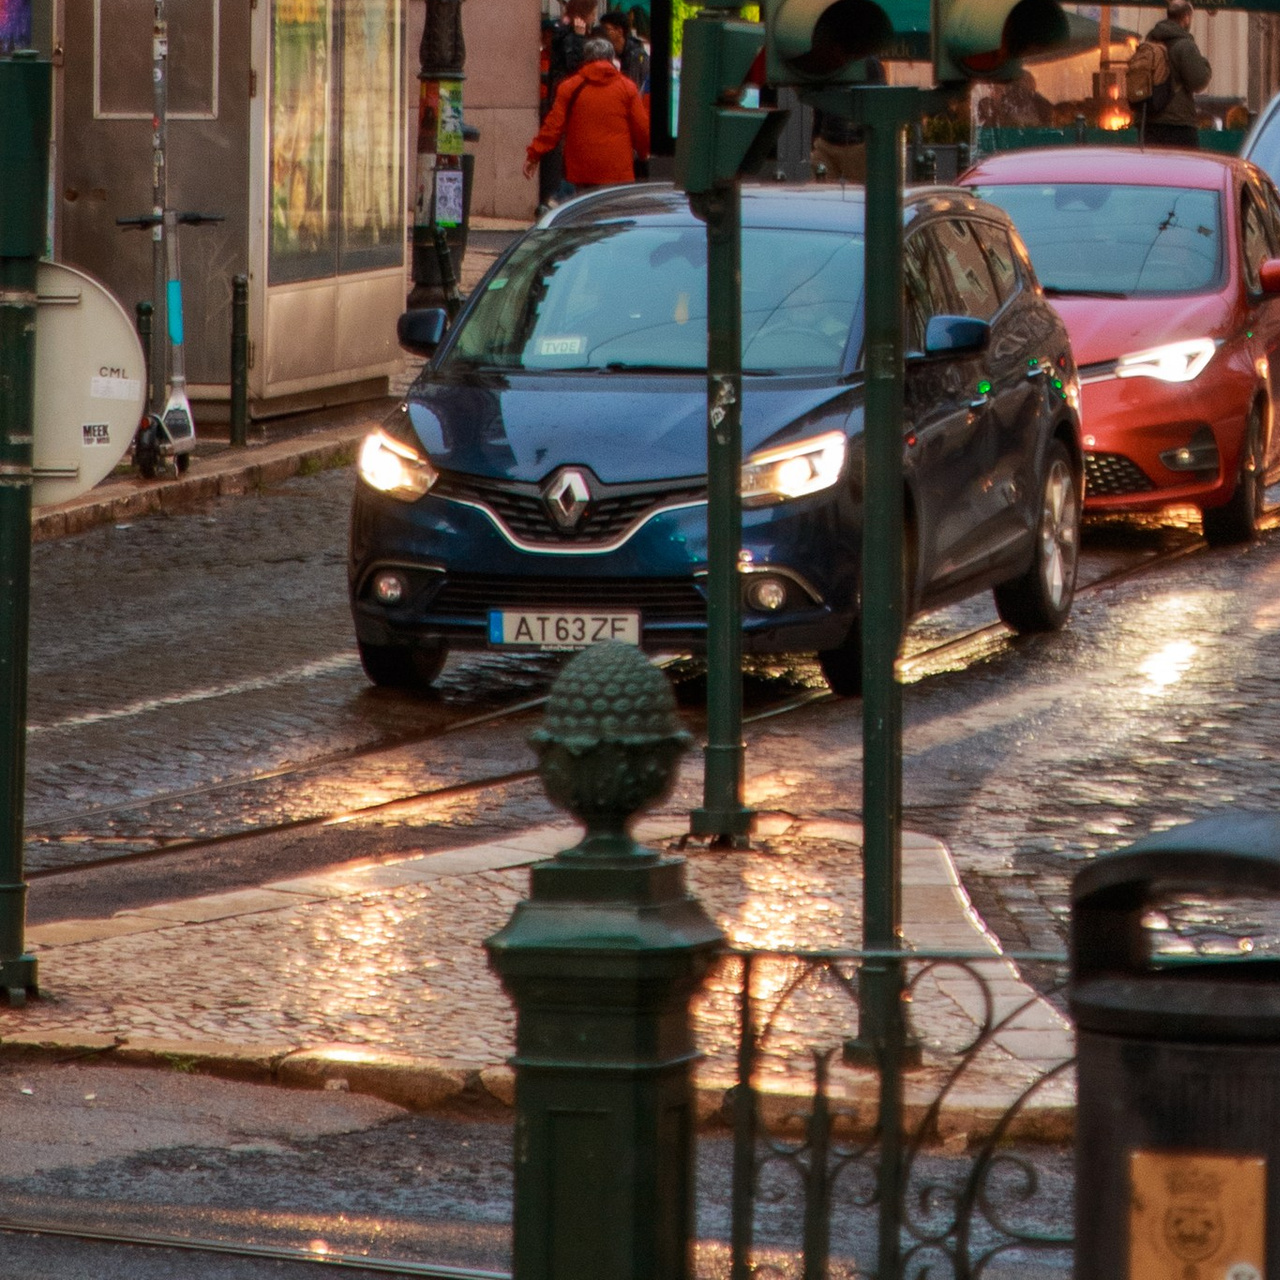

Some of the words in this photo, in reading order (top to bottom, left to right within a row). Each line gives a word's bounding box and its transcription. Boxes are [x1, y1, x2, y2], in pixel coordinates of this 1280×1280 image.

[544, 341, 577, 353] TVDE
[99, 367, 129, 379] CML
[83, 424, 109, 438] MEEK
[514, 616, 629, 641] AT63ZF
